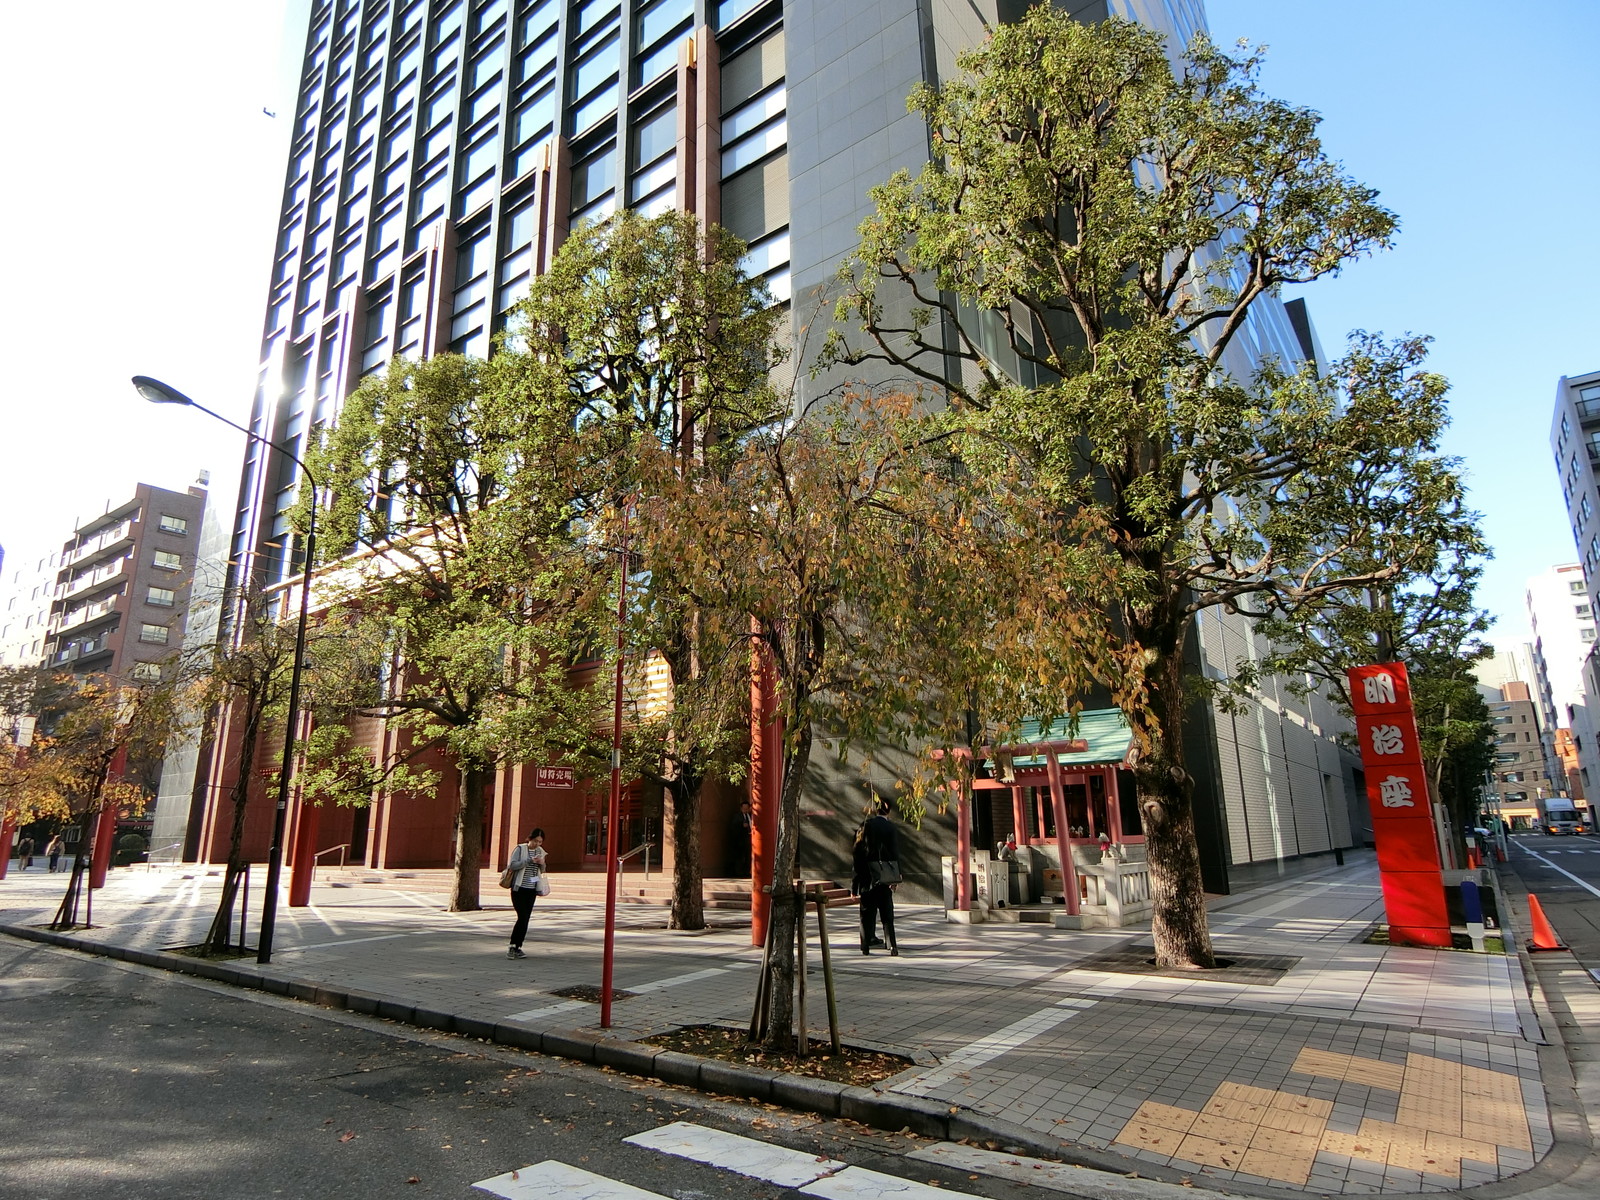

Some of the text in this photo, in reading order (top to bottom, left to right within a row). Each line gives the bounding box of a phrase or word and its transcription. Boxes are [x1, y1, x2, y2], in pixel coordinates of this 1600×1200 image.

[539, 769, 572, 780] 切符売場
[1362, 673, 1415, 808] 明治座
